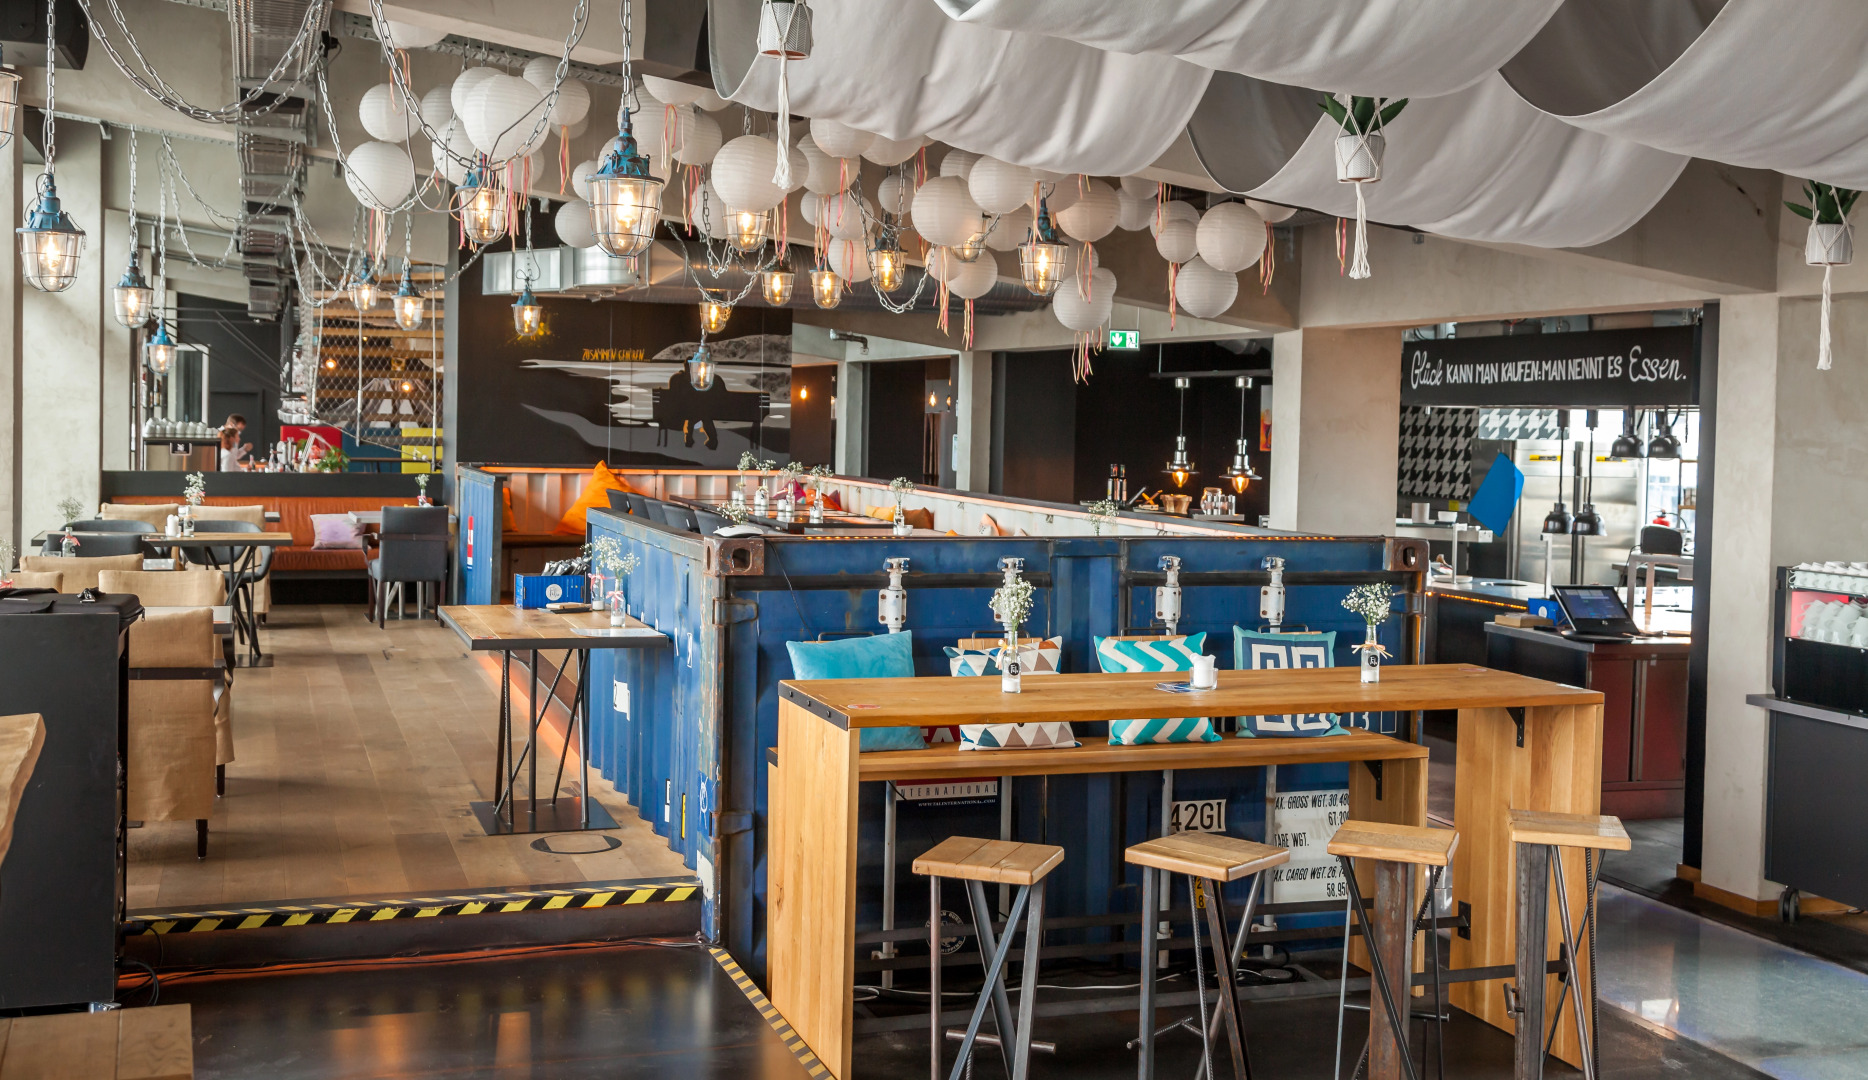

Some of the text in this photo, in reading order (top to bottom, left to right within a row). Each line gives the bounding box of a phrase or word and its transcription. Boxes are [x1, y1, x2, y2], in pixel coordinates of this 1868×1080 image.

[1411, 350, 1443, 389] Glück
[1446, 363, 1473, 384] KANN
[1476, 362, 1499, 384] MAN
[1542, 358, 1566, 381] MAN
[1567, 356, 1604, 380] NENNT
[1607, 355, 1623, 378] ES
[1629, 345, 1687, 382] Essen.
[901, 783, 997, 797] NTERNATIONAL
[1275, 796, 1286, 809] AX.
[1288, 795, 1309, 809] GROSS
[1291, 832, 1309, 847] WGT.
[1274, 869, 1284, 882] AX.
[1286, 867, 1308, 881] CARGO
